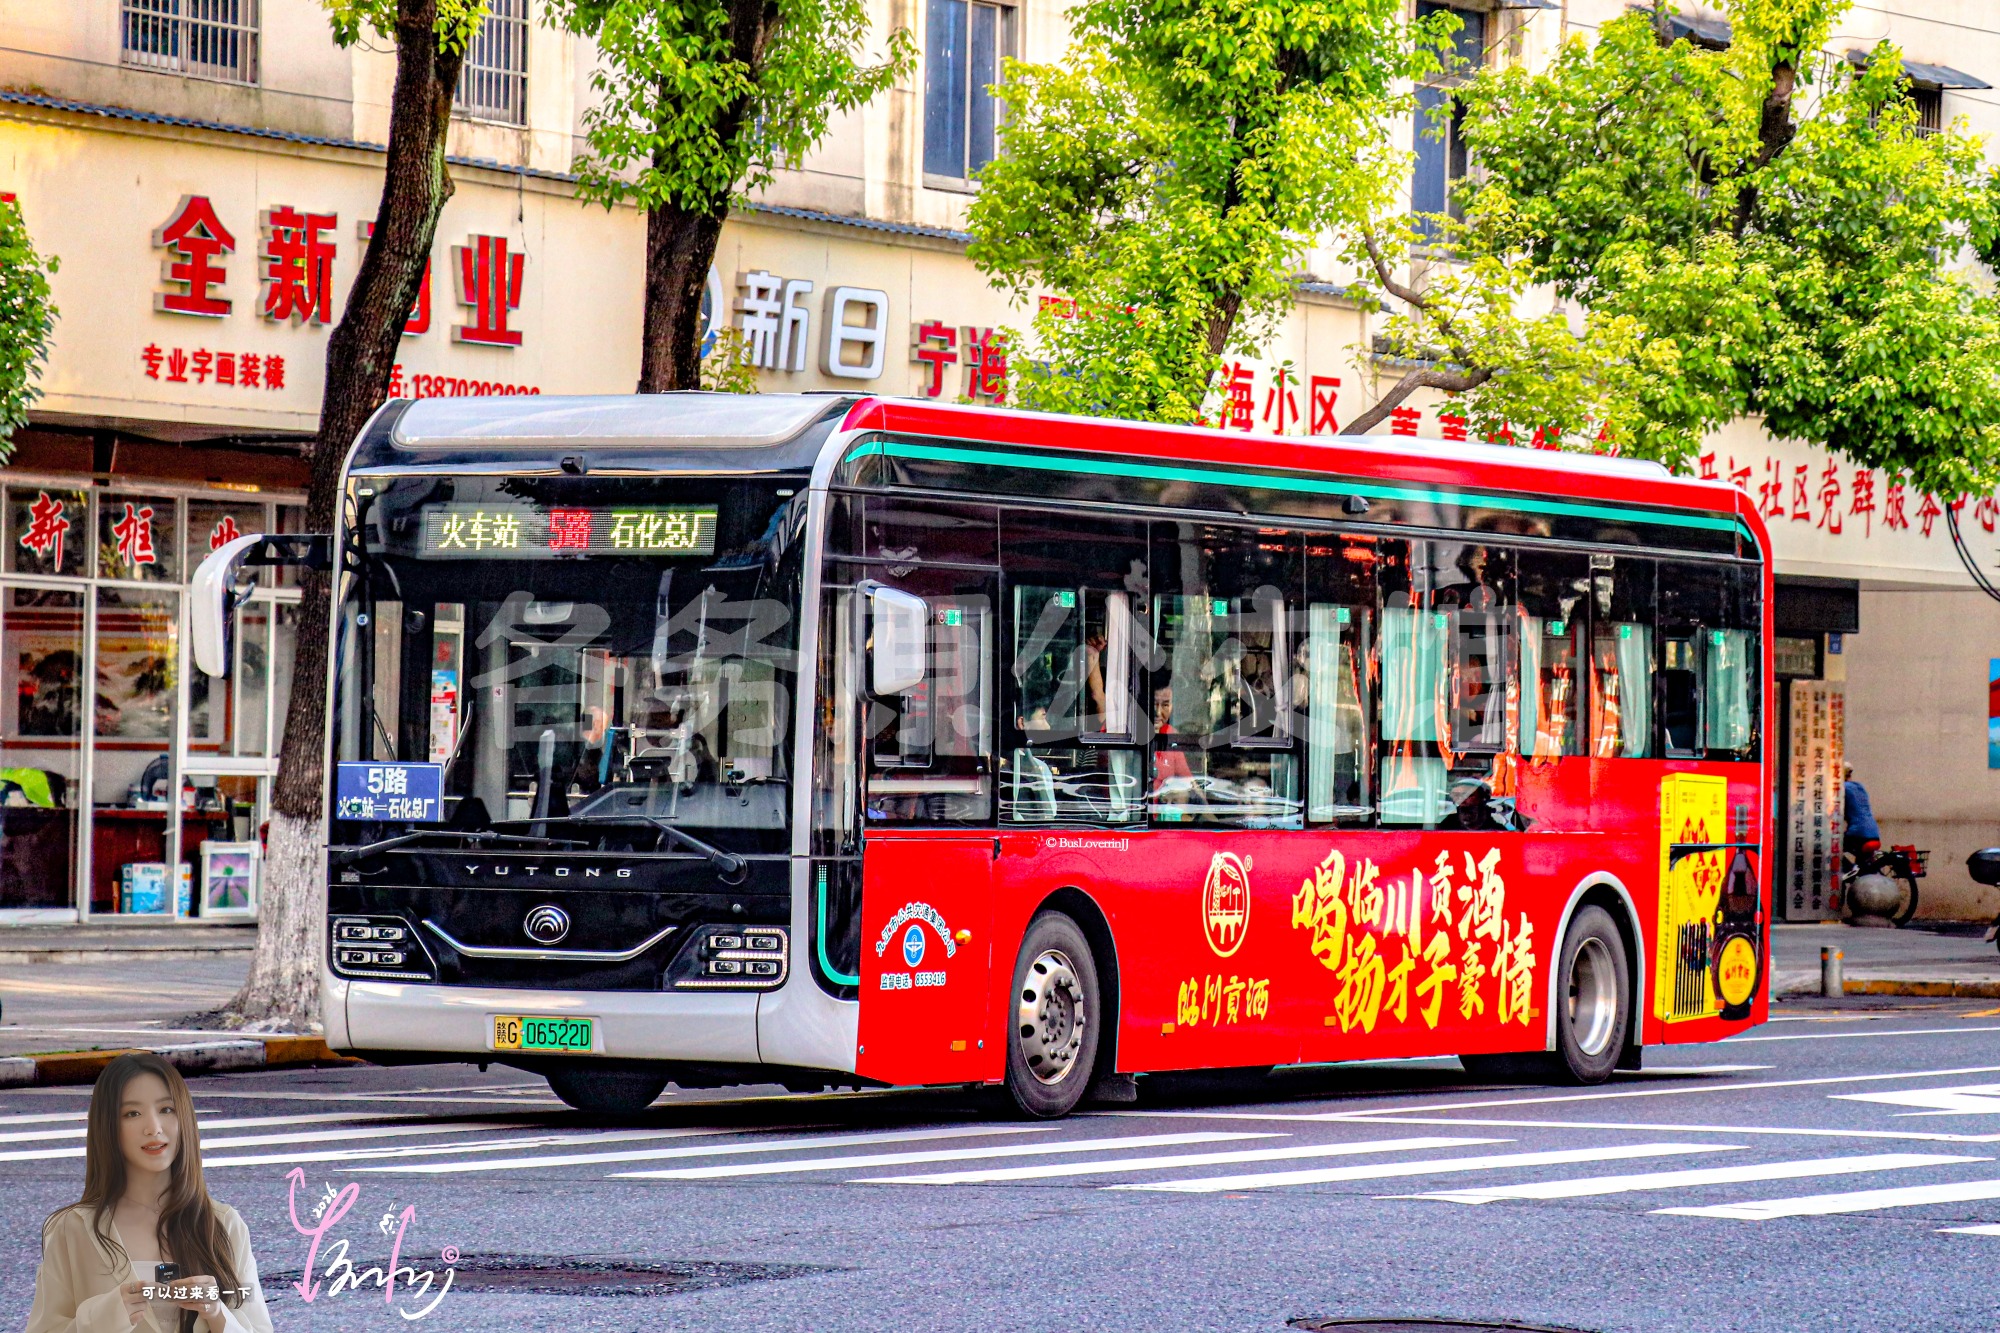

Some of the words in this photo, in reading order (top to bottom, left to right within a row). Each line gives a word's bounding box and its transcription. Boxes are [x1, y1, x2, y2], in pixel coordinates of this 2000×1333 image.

[153, 194, 525, 347] 全新业
[736, 270, 888, 379] 新日
[438, 511, 520, 550] 火车站
[610, 511, 718, 549] 石化总厂
[367, 767, 408, 795] 5路
[388, 797, 435, 818] 石化总厂
[466, 865, 632, 878] YUTONG
[876, 902, 956, 958] 九江市公共交通集团公司
[1333, 911, 1536, 1034] 扬才子豪情
